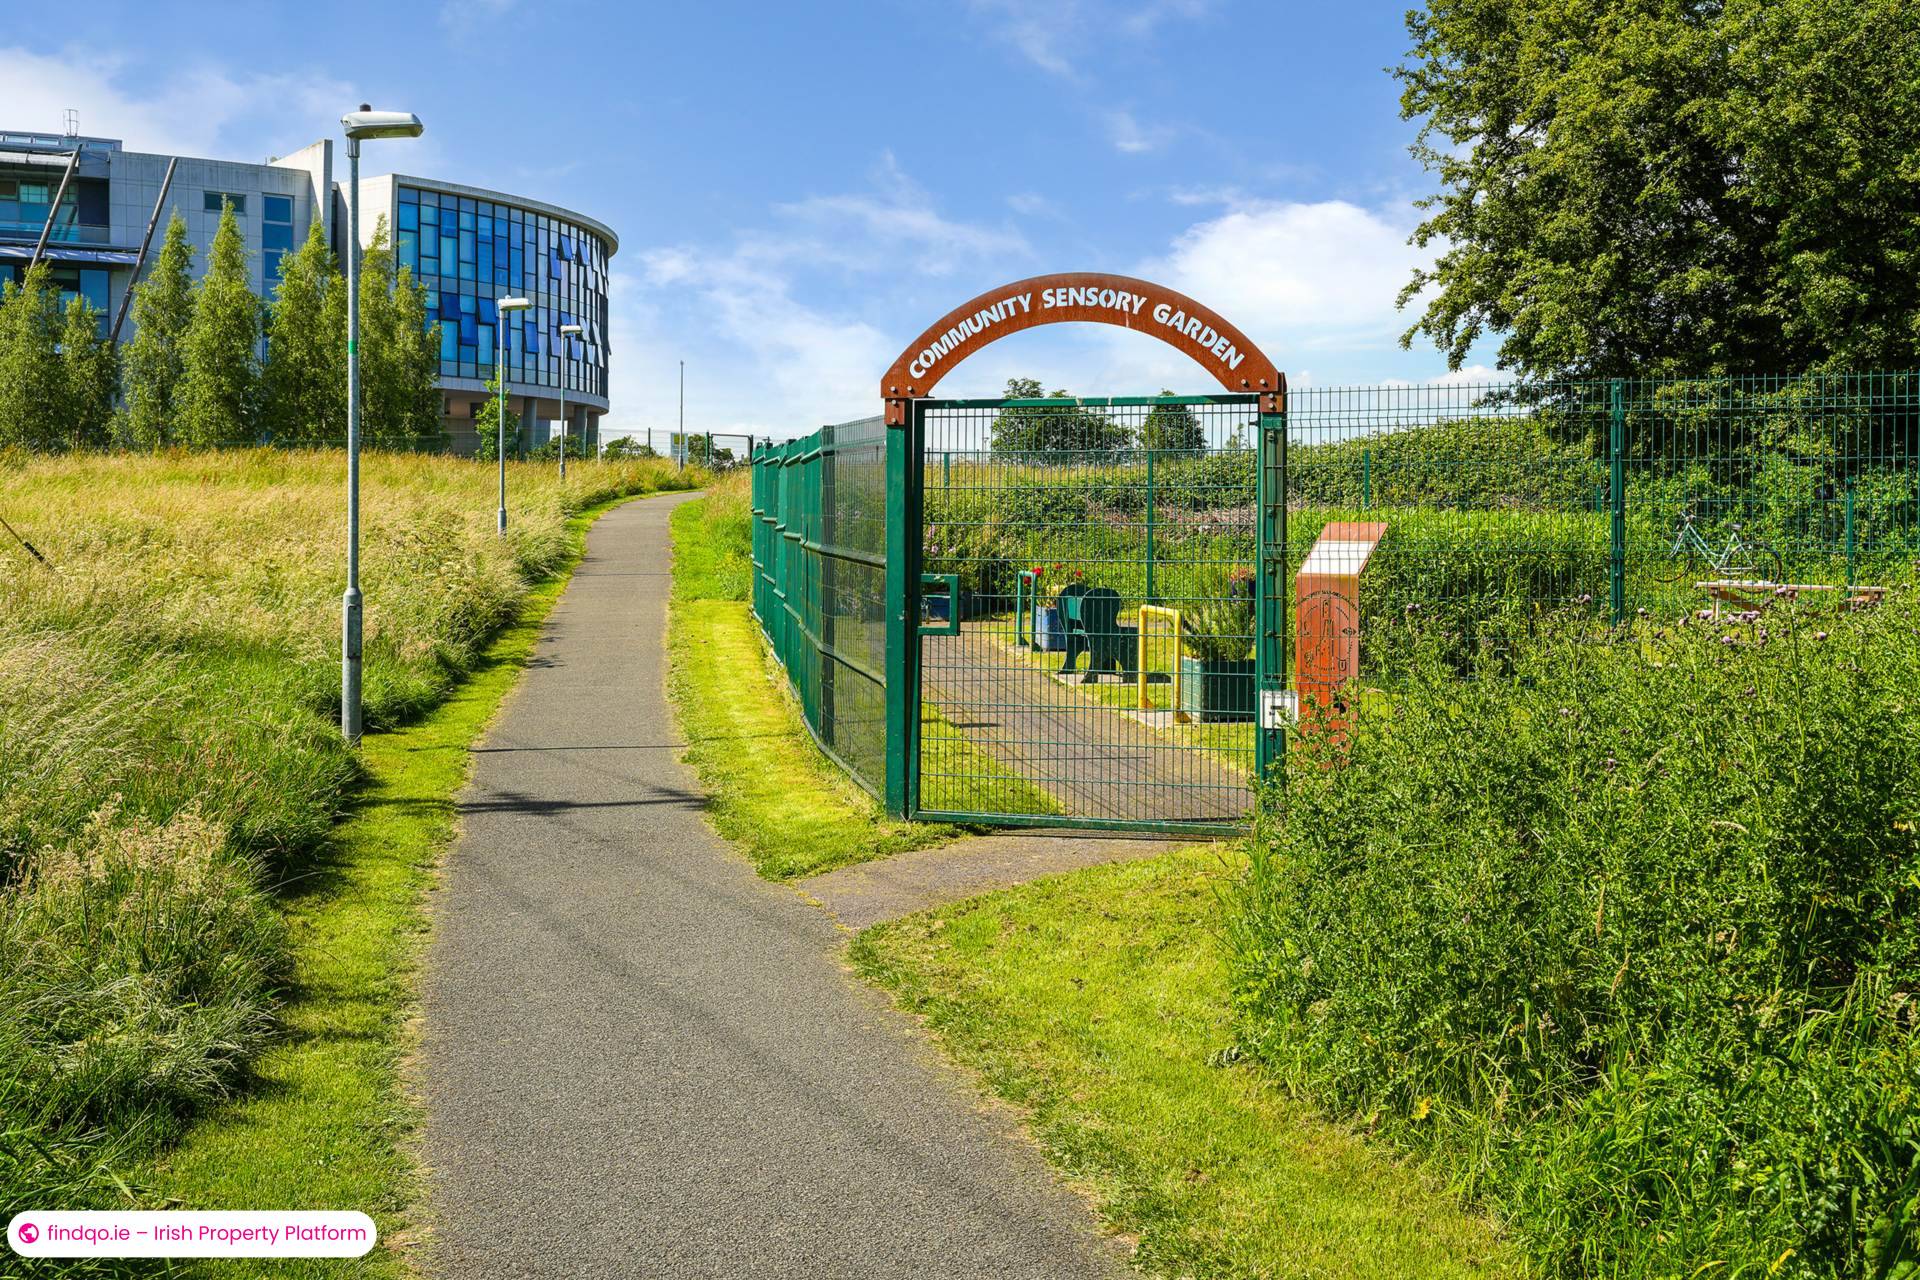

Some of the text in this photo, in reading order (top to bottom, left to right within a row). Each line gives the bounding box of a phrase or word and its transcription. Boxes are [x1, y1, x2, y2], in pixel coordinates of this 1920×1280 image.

[909, 287, 1245, 379] COMMUNITY SENSORY GARDEN
